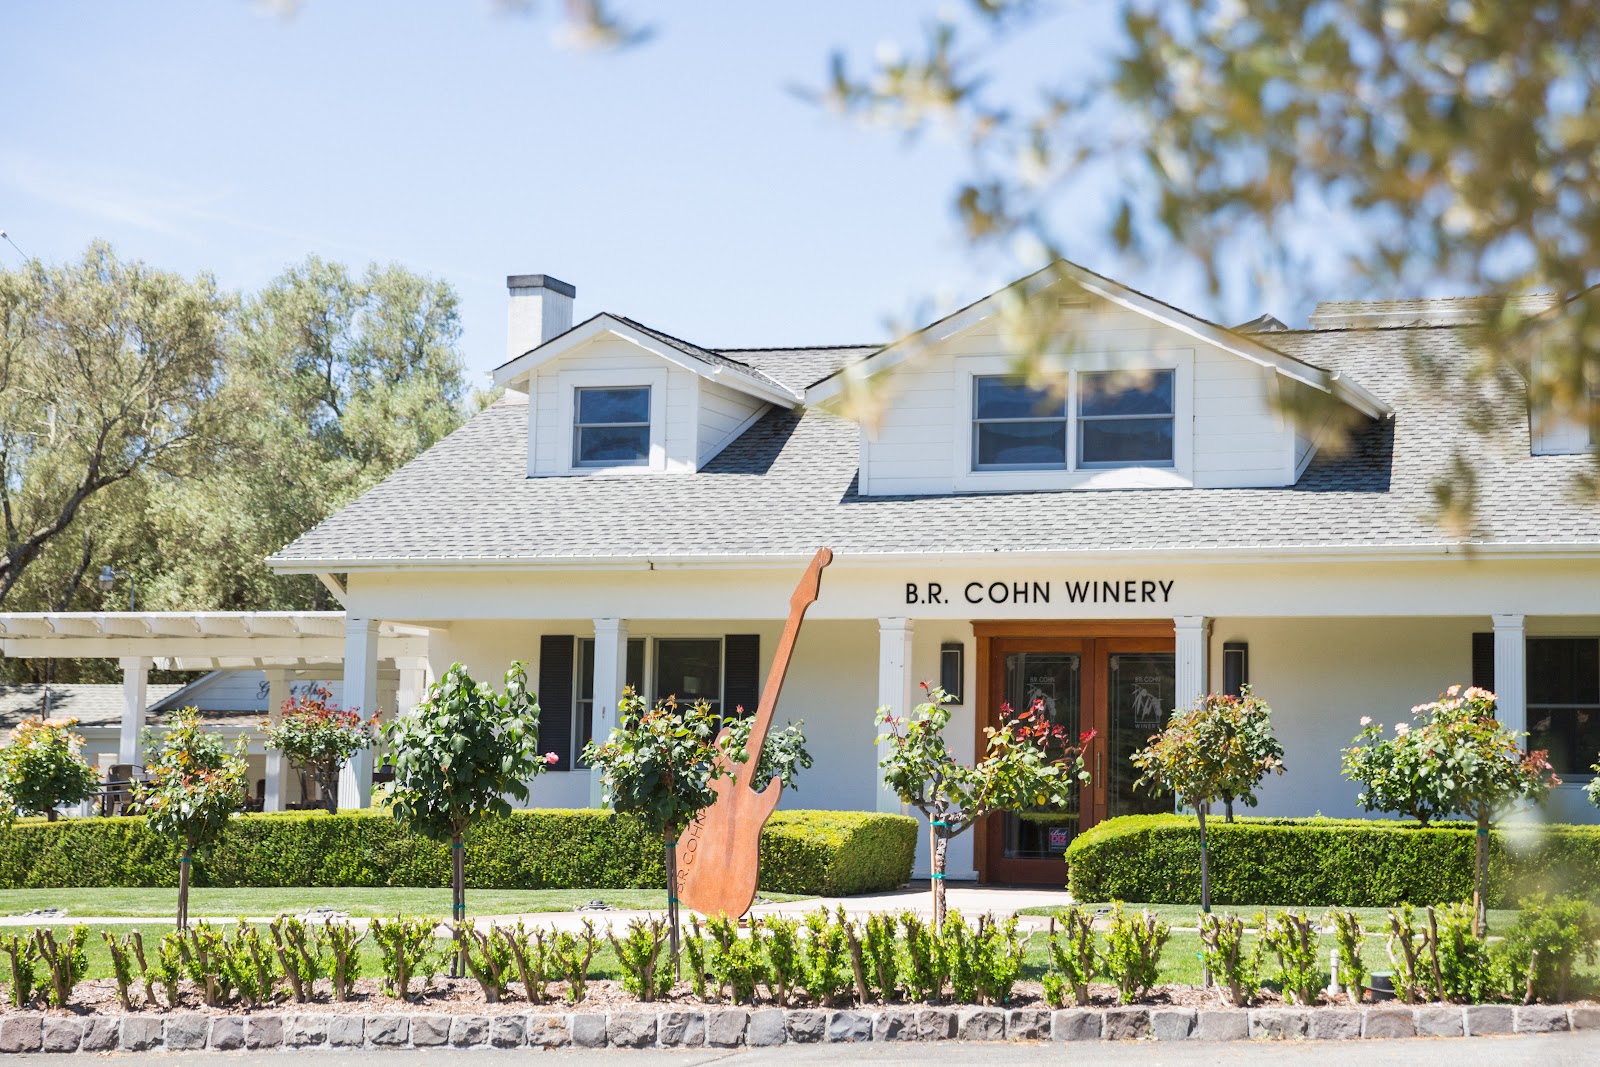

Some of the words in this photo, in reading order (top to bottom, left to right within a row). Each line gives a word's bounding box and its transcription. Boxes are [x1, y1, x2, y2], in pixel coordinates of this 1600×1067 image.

[905, 583, 949, 604] B.R.
[964, 582, 1050, 604] COHN
[1065, 580, 1175, 603] WINERY
[683, 812, 707, 865] COHN
